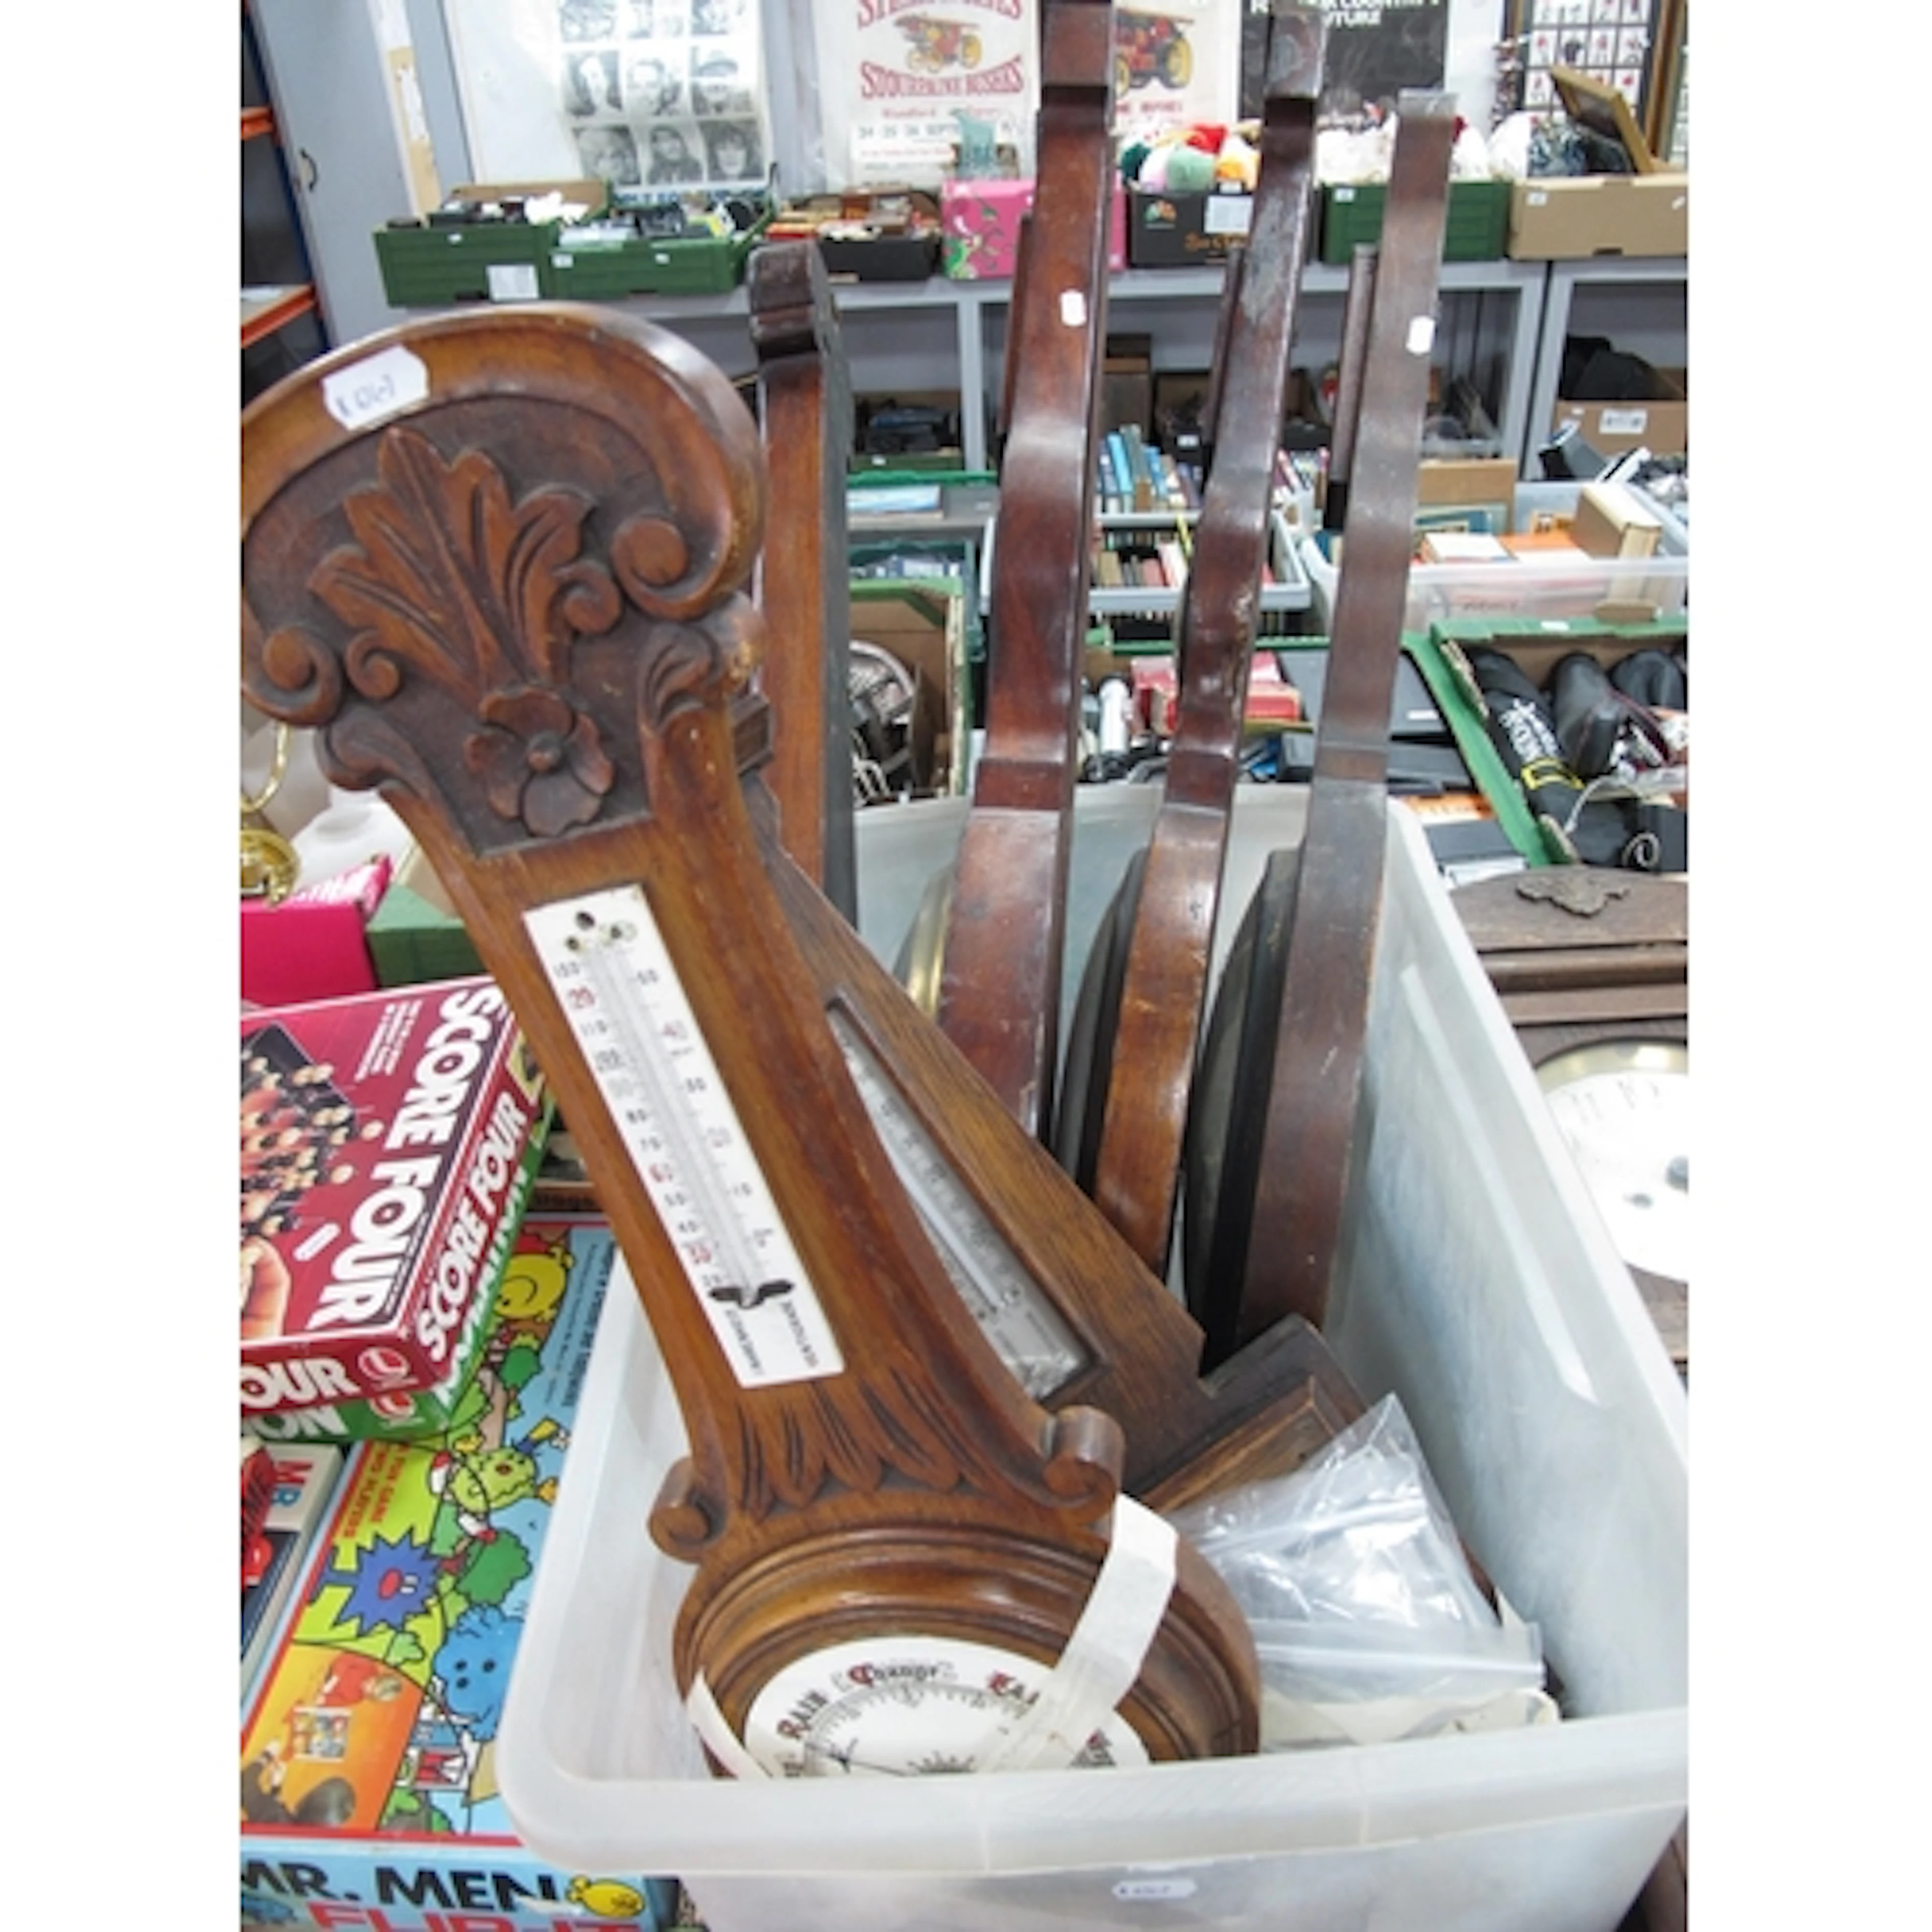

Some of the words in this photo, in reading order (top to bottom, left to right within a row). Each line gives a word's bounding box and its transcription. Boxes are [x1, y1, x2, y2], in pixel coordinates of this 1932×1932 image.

[384, 985, 507, 1151] SCORE
[305, 1155, 442, 1330] FOUR
[415, 1195, 489, 1362] SCORE
[469, 1090, 527, 1216] FOUR
[375, 1866, 559, 1912] MEN
